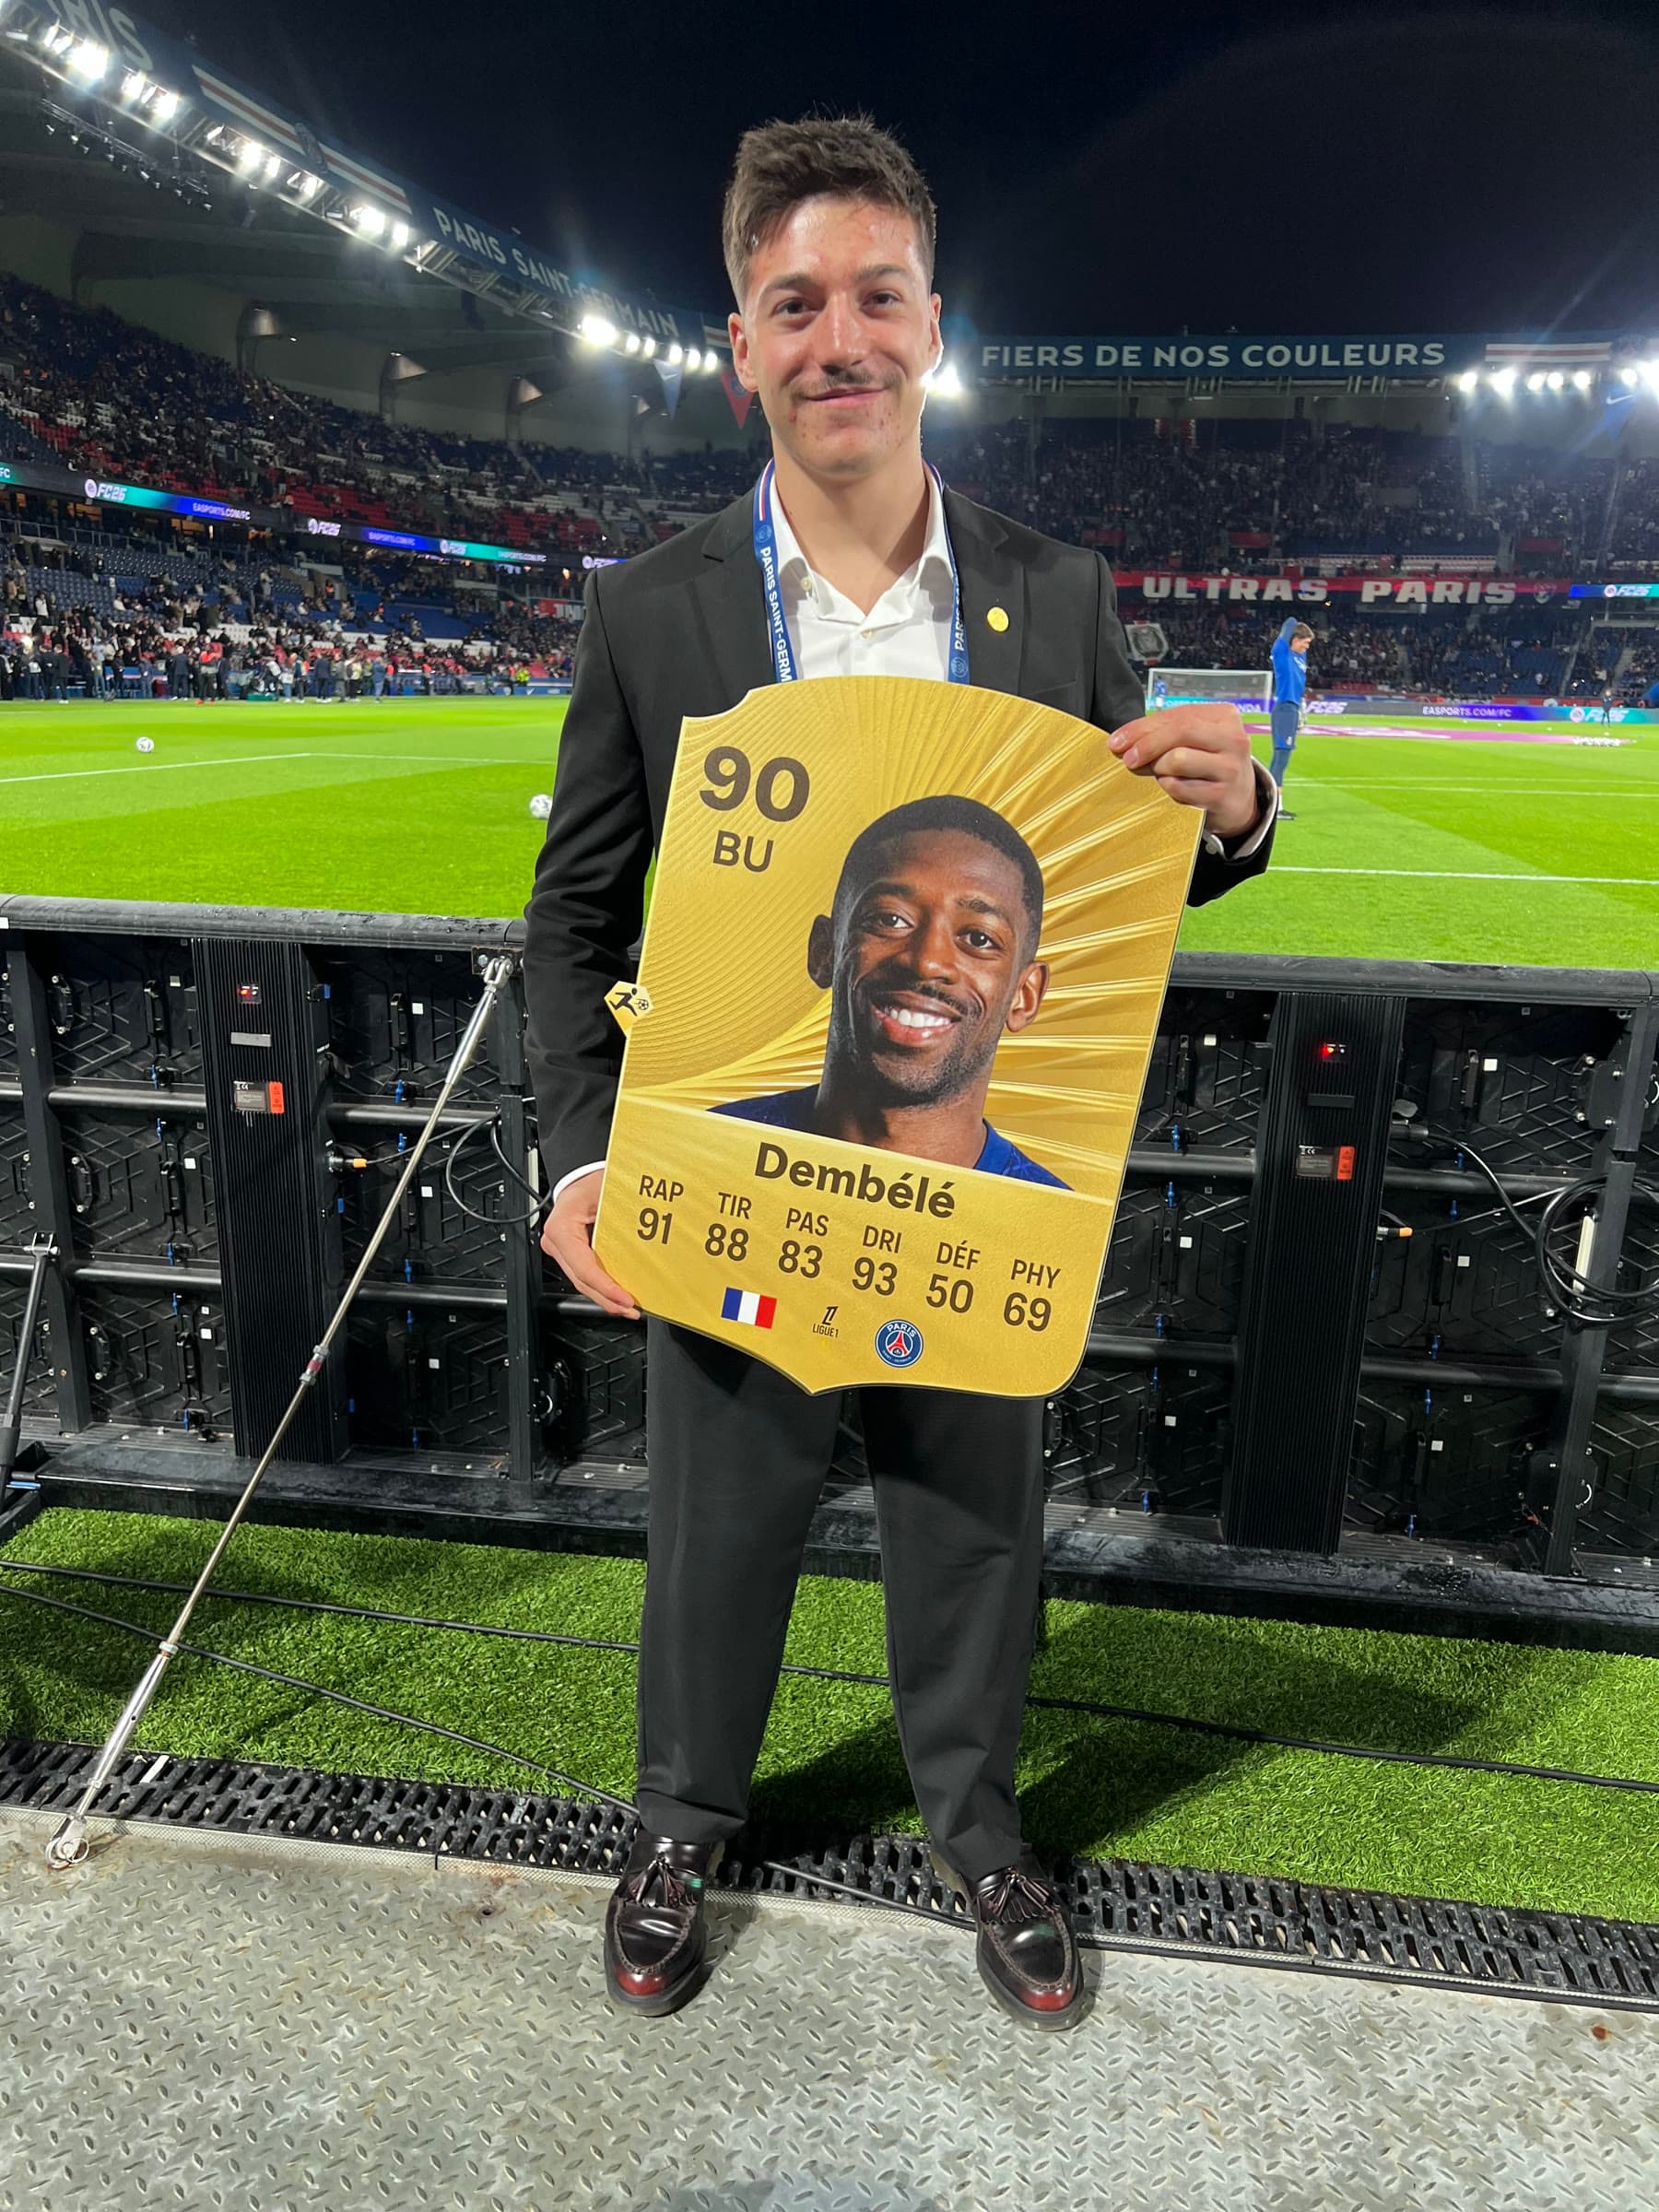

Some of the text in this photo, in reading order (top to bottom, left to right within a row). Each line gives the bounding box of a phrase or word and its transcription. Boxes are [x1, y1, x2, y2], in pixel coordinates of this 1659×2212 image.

[433, 206, 680, 338] PARIS SAINT-GERMAIN
[982, 343, 1445, 368] FIERS DE NOS COULEURS
[760, 546, 775, 591] PARIS
[1143, 576, 1516, 604] ULTRAS PARIS
[700, 746, 810, 823] 90
[713, 830, 774, 873] BU
[755, 1142, 956, 1218] Dembélé
[639, 1175, 1061, 1289] RAP TIR PAS DRI DÉF PHY
[637, 1207, 1052, 1332] 91 88 83 93 50 69
[887, 1323, 916, 1337] PARIS
